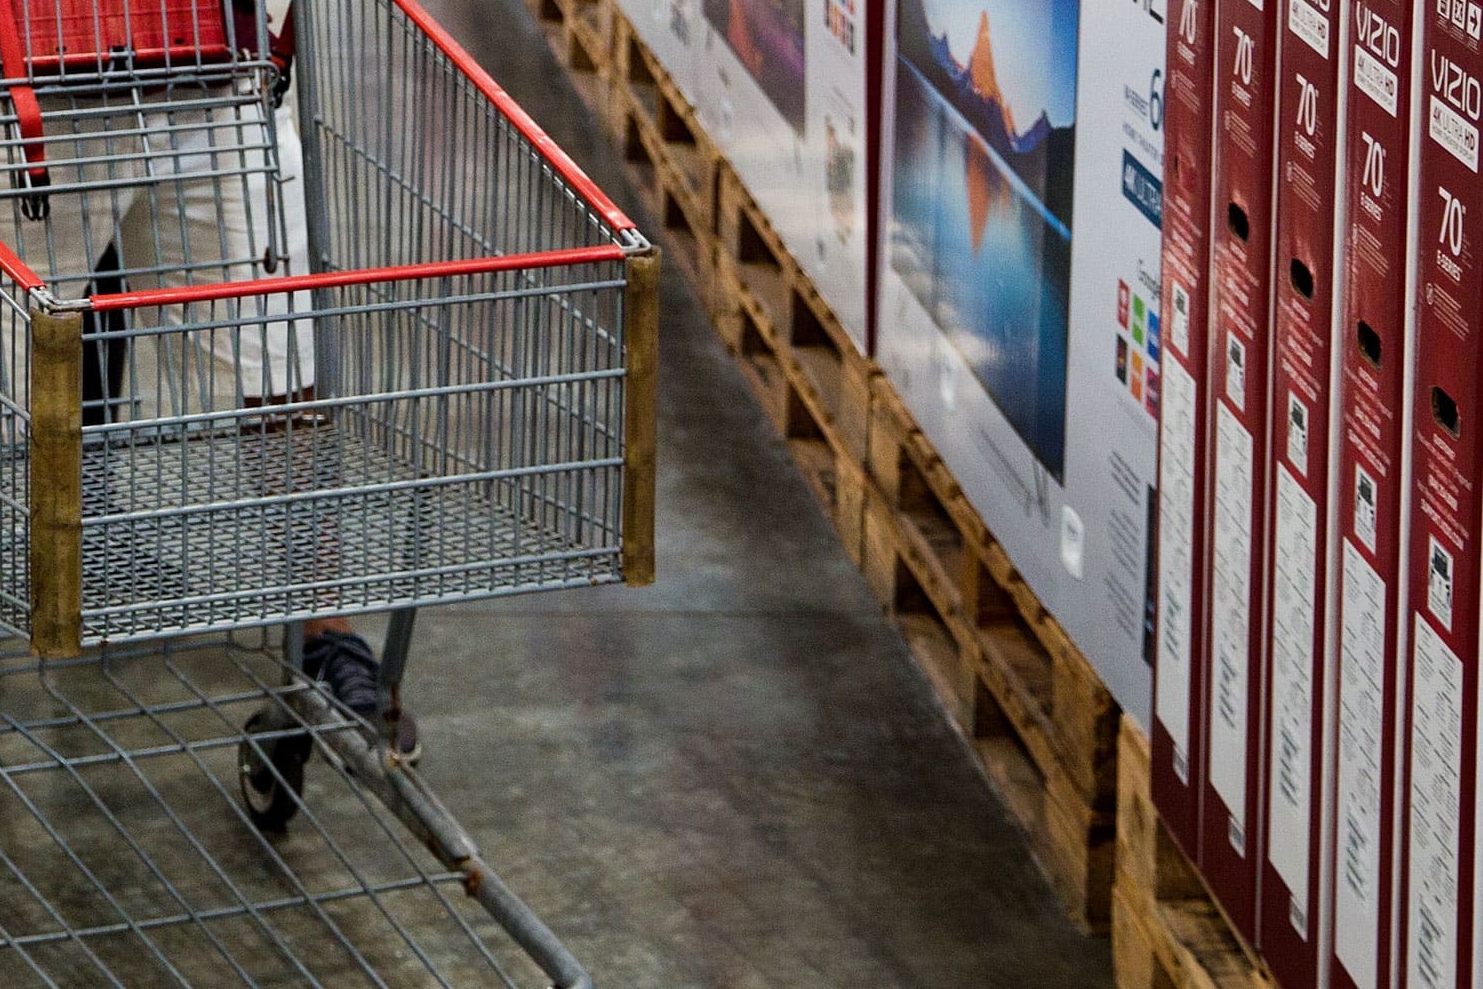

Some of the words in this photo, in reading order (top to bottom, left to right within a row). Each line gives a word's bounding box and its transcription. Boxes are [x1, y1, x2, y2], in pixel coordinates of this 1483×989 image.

[1356, 1, 1400, 68] VIZIO
[1150, 68, 1162, 130] 6
[1431, 49, 1481, 121] VIZIO
